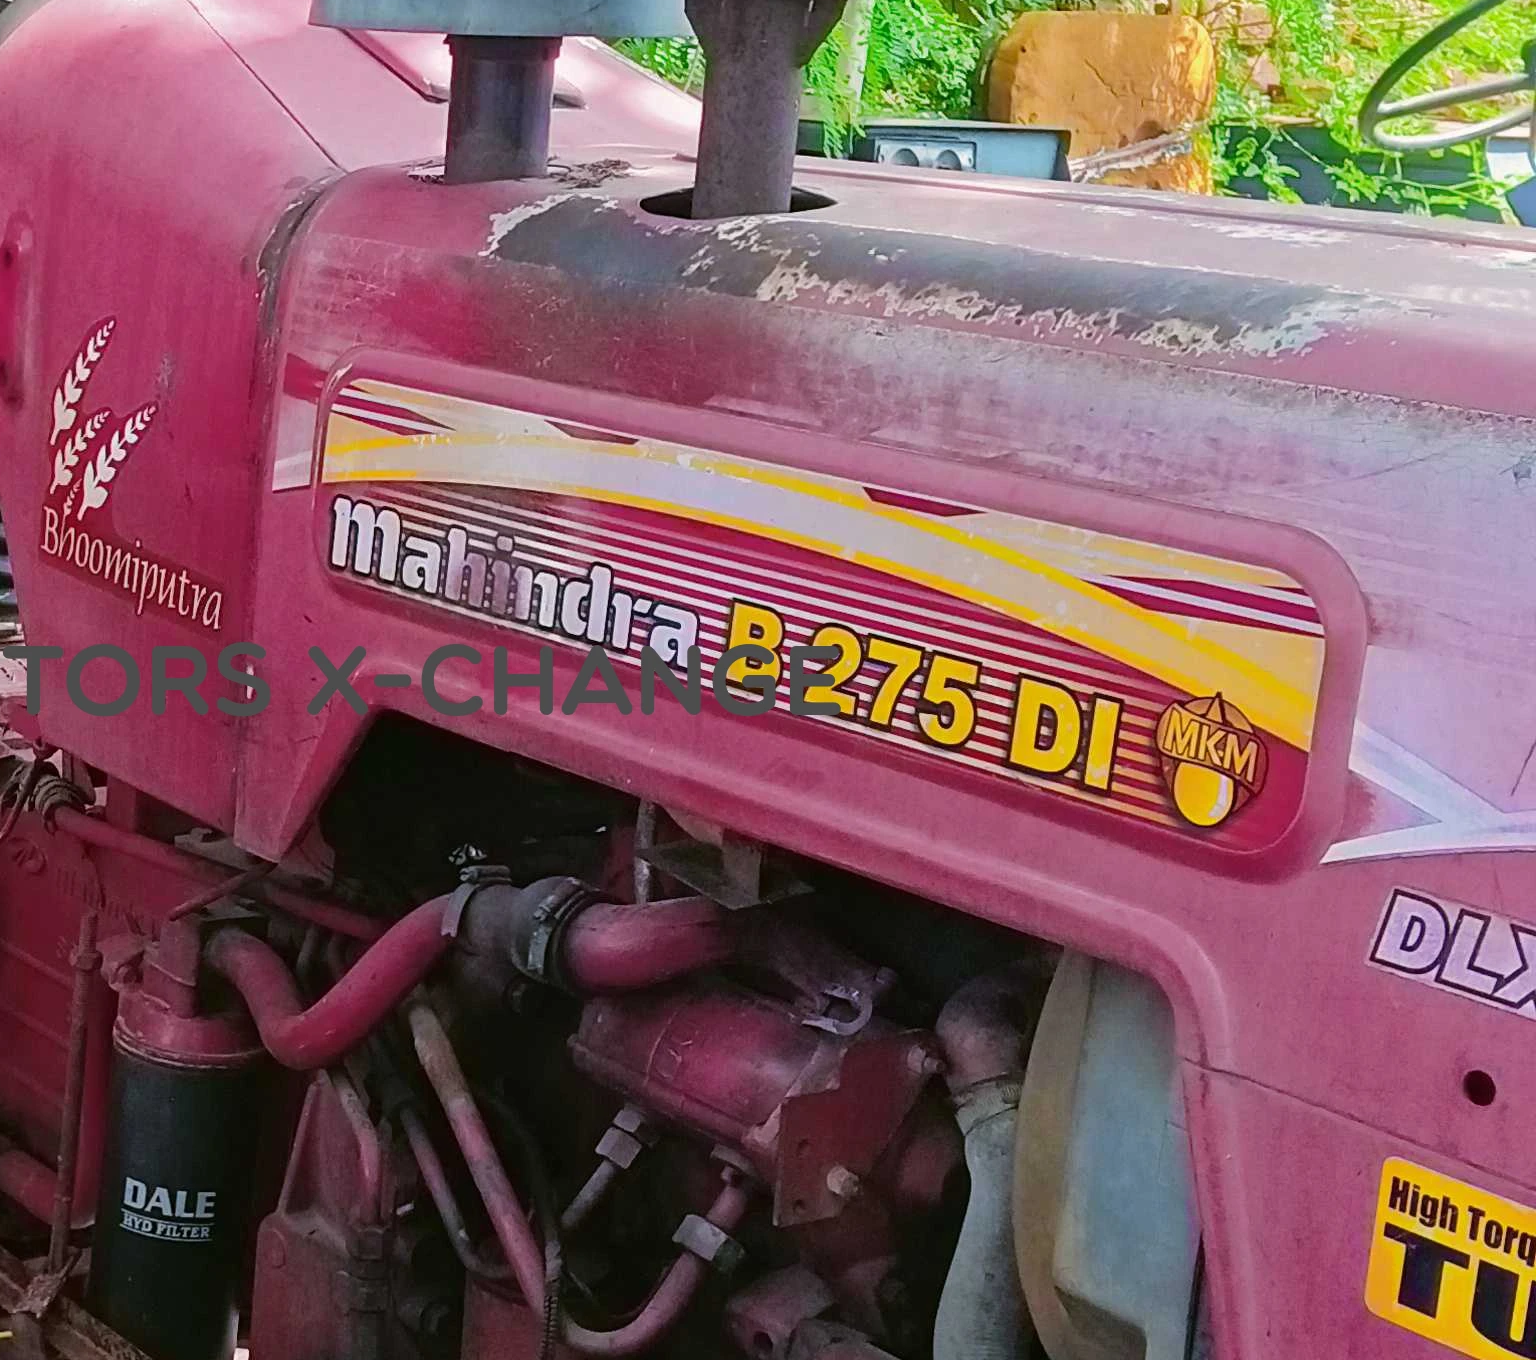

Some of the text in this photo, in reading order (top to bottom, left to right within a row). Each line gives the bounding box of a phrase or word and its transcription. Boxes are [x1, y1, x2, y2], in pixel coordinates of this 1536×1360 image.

[41, 506, 223, 632] Bhoomiputra
[329, 493, 1125, 795] Mahindra B 275 DI
[1162, 706, 1260, 783] MKM
[122, 1210, 211, 1239] HYD FILTER
[123, 1176, 216, 1219] DALE
[1388, 1175, 1536, 1268] High Torq
[1383, 1221, 1536, 1360] TU
